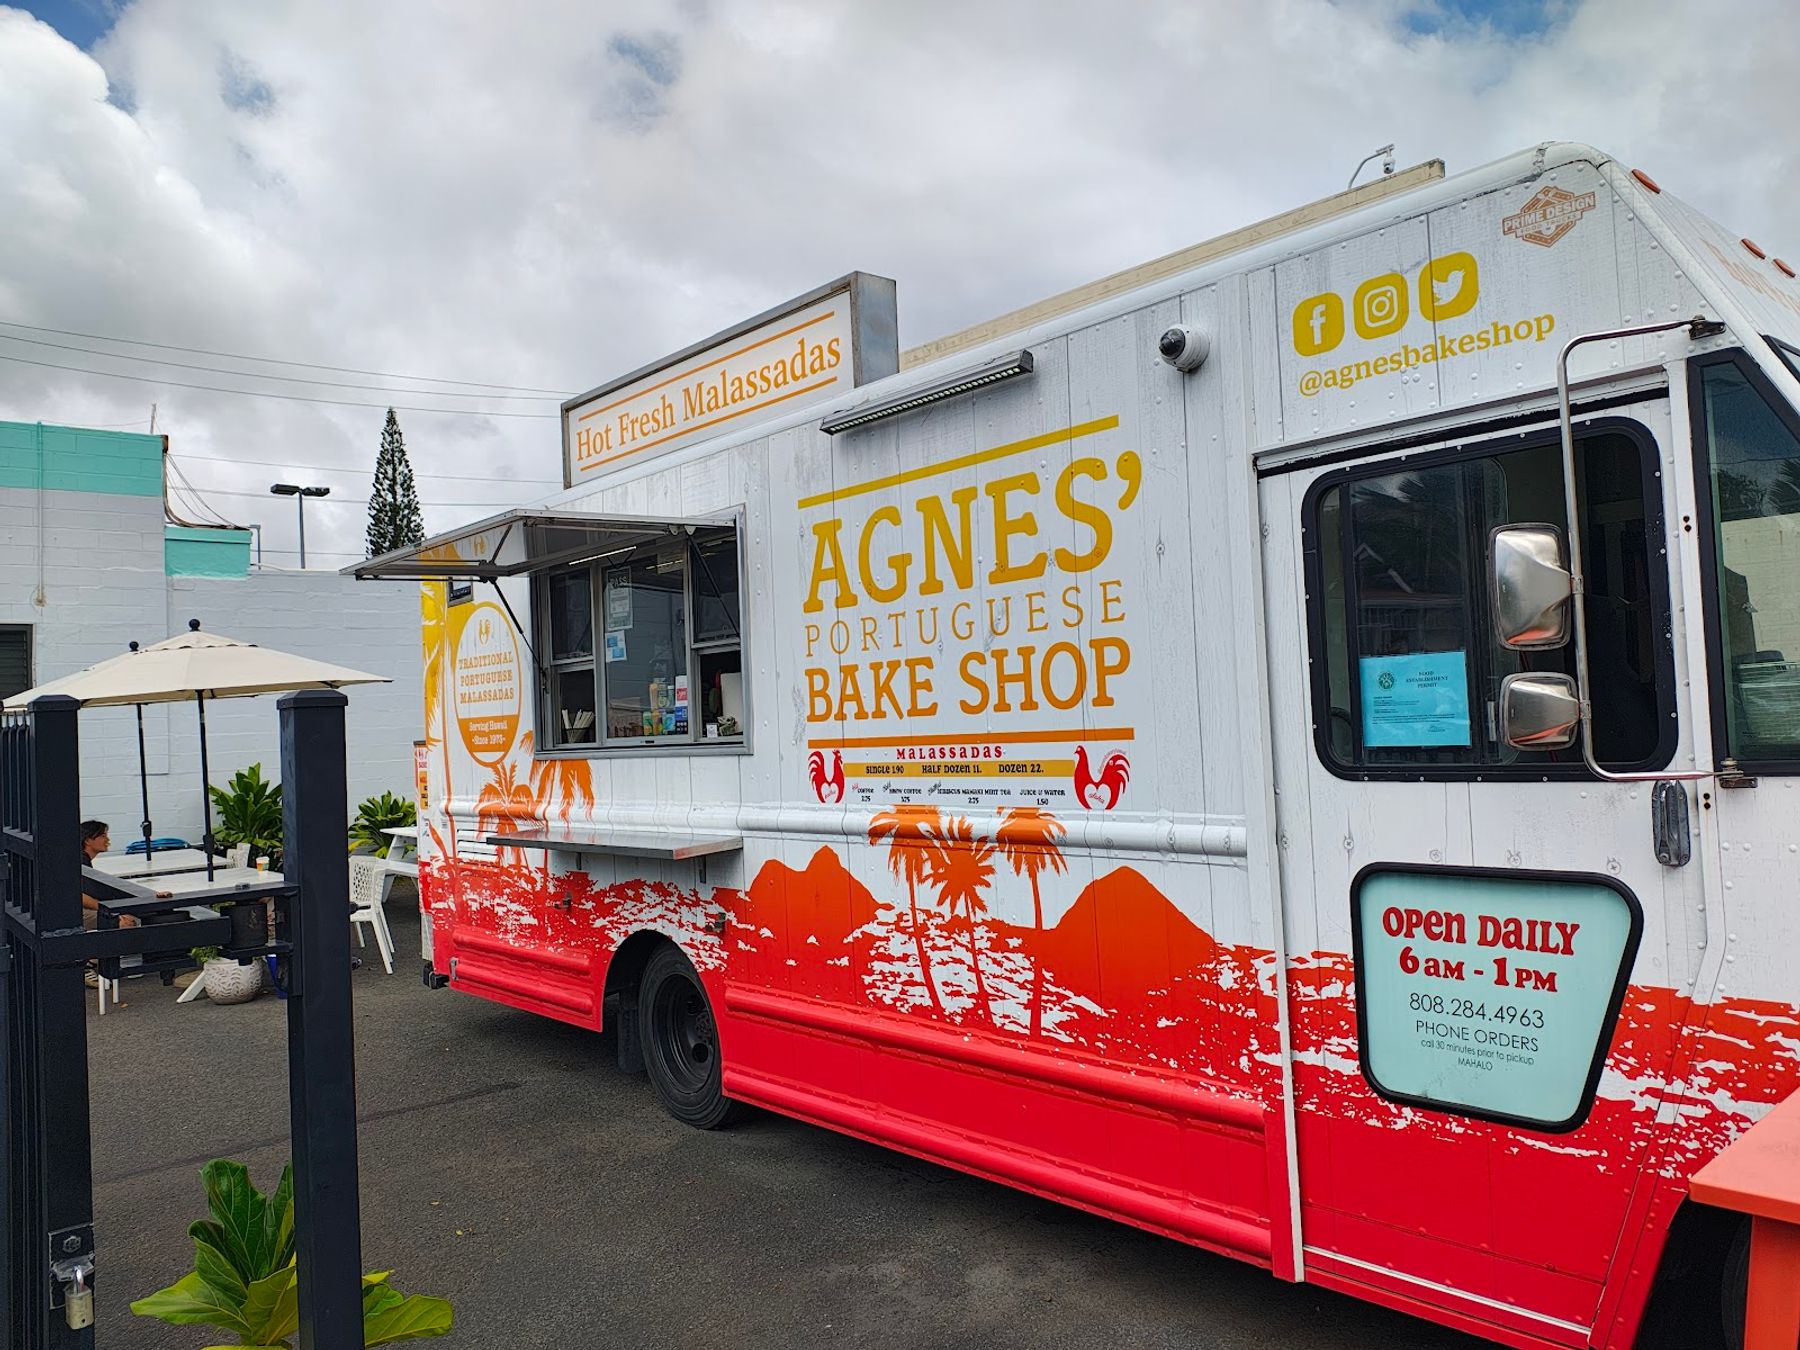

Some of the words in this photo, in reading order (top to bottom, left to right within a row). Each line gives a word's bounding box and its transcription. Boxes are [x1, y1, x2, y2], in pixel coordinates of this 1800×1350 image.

[1504, 209, 1544, 232] PRIME
[1546, 195, 1595, 219] DESIGN
[1299, 313, 1556, 396] @agnesbakeshop
[577, 424, 611, 461] Hot
[618, 394, 675, 446] Fresh
[683, 337, 841, 421] Malassadas
[803, 450, 1142, 614] AGNES'
[805, 580, 1126, 657] PORTUGUESE
[459, 651, 513, 671] TRADITIONAL
[460, 670, 513, 687] PORTUGUESE
[805, 657, 938, 722] BAKE
[959, 637, 1131, 715] SHOP
[460, 688, 514, 704] MALASSADAS
[1030, 763, 1044, 773] 22.
[1409, 992, 1545, 1029] 808.284.4963
[1416, 1020, 1470, 1041] PHONE
[1474, 1029, 1539, 1052] ORDERS
[1421, 1040, 1434, 1048] call
[1436, 1041, 1445, 1050] 30
[1446, 1043, 1475, 1055] minutes
[1477, 1048, 1494, 1057] prior
[1496, 1051, 1505, 1060] to
[1506, 1052, 1534, 1065] pickup
[1458, 1058, 1493, 1071] MAHALO
